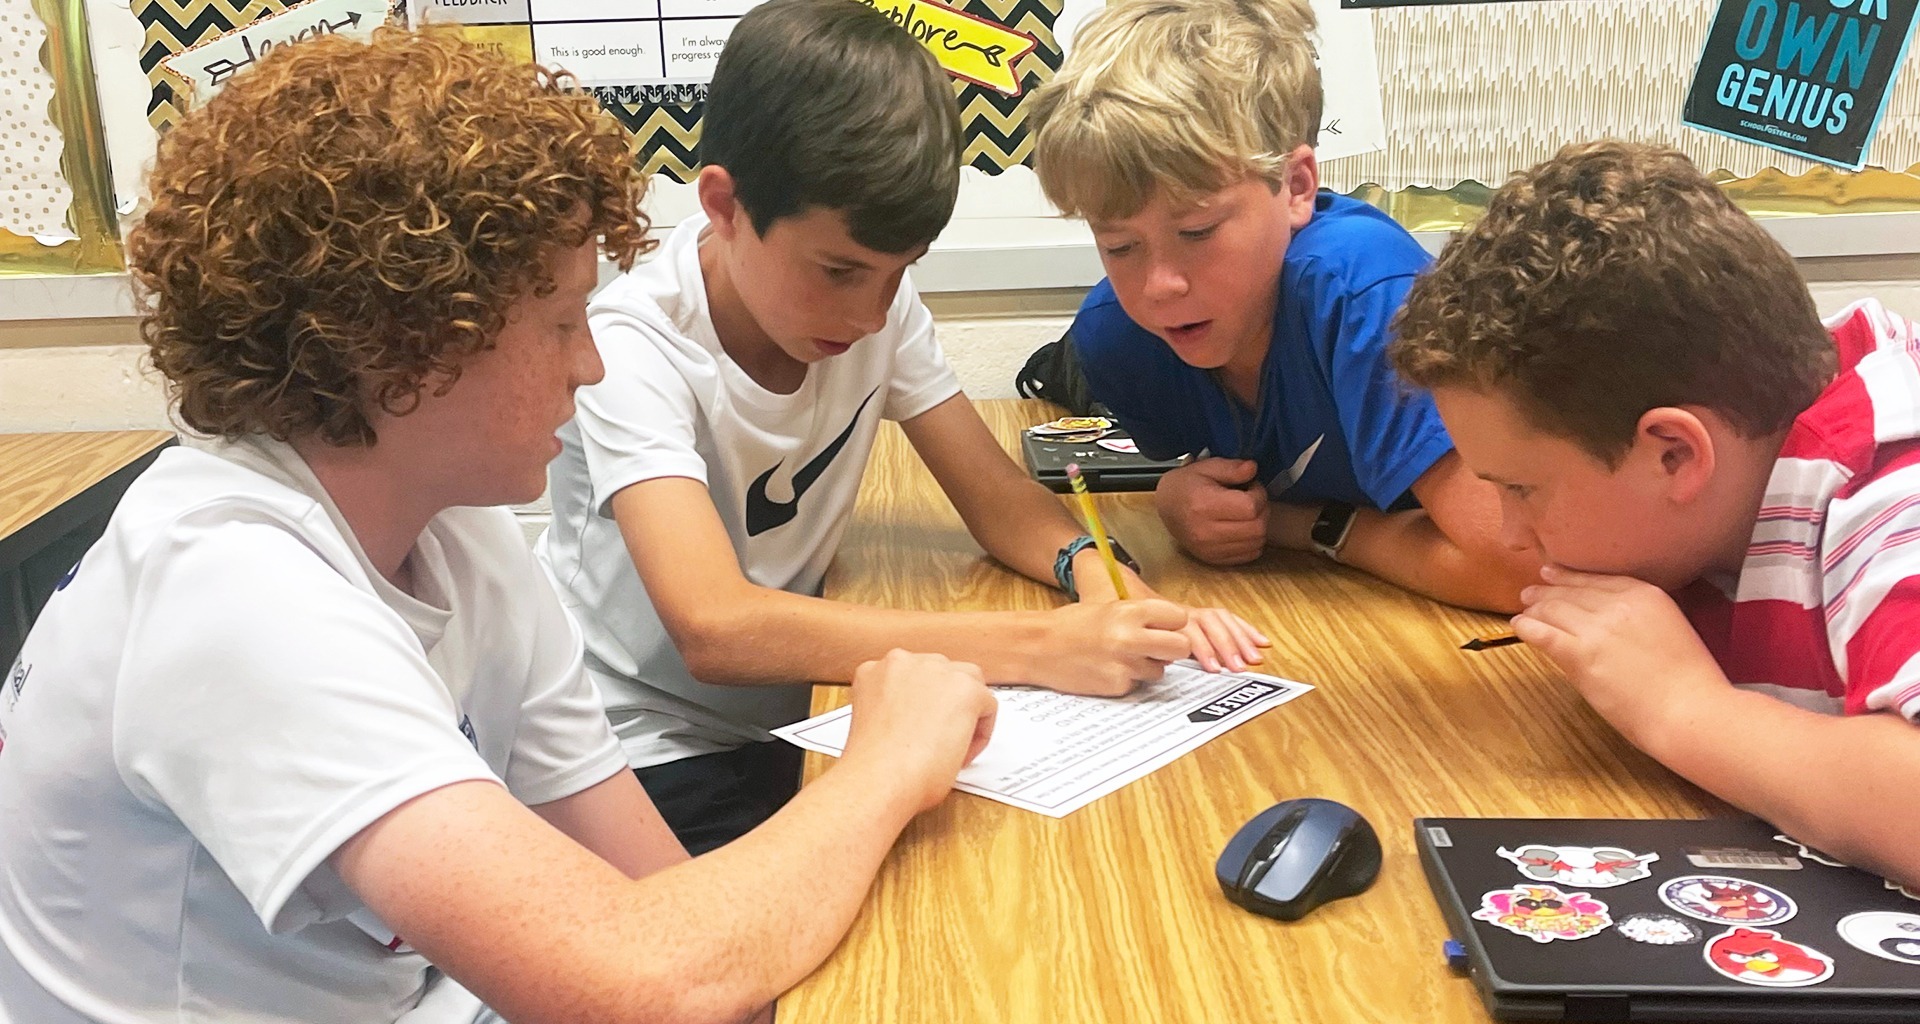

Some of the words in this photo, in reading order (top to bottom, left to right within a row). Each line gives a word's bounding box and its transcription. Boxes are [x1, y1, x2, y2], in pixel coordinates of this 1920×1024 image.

[242, 19, 335, 61] lern
[550, 46, 569, 56] This
[572, 46, 579, 56] is
[581, 44, 606, 59] good
[608, 44, 646, 58] enough.
[682, 37, 697, 46] I'm
[1735, 0, 1881, 90] OWN
[671, 52, 711, 62] progress
[1716, 63, 1854, 135] GENIUS
[1215, 683, 1274, 708] PUZZLE
